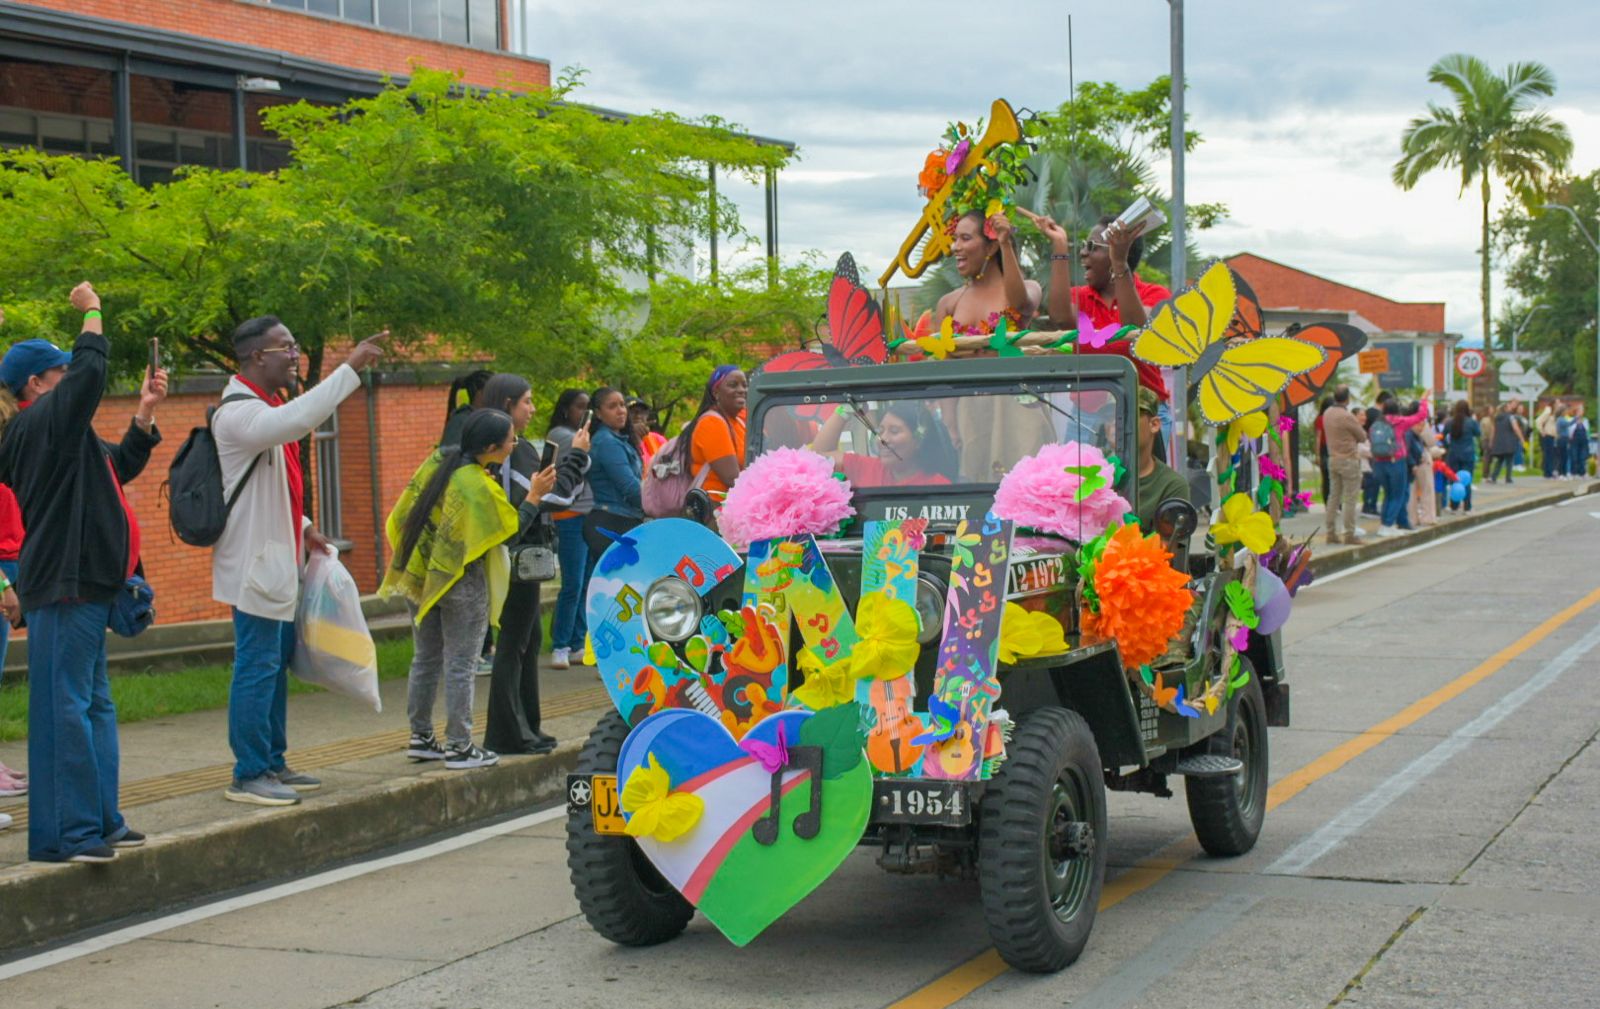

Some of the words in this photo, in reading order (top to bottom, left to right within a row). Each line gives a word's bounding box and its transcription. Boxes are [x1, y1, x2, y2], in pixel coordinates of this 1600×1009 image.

[1462, 356, 1479, 370] 20
[919, 505, 970, 520] ARMY
[1030, 557, 1065, 589] 1972
[892, 789, 962, 815] 1954
